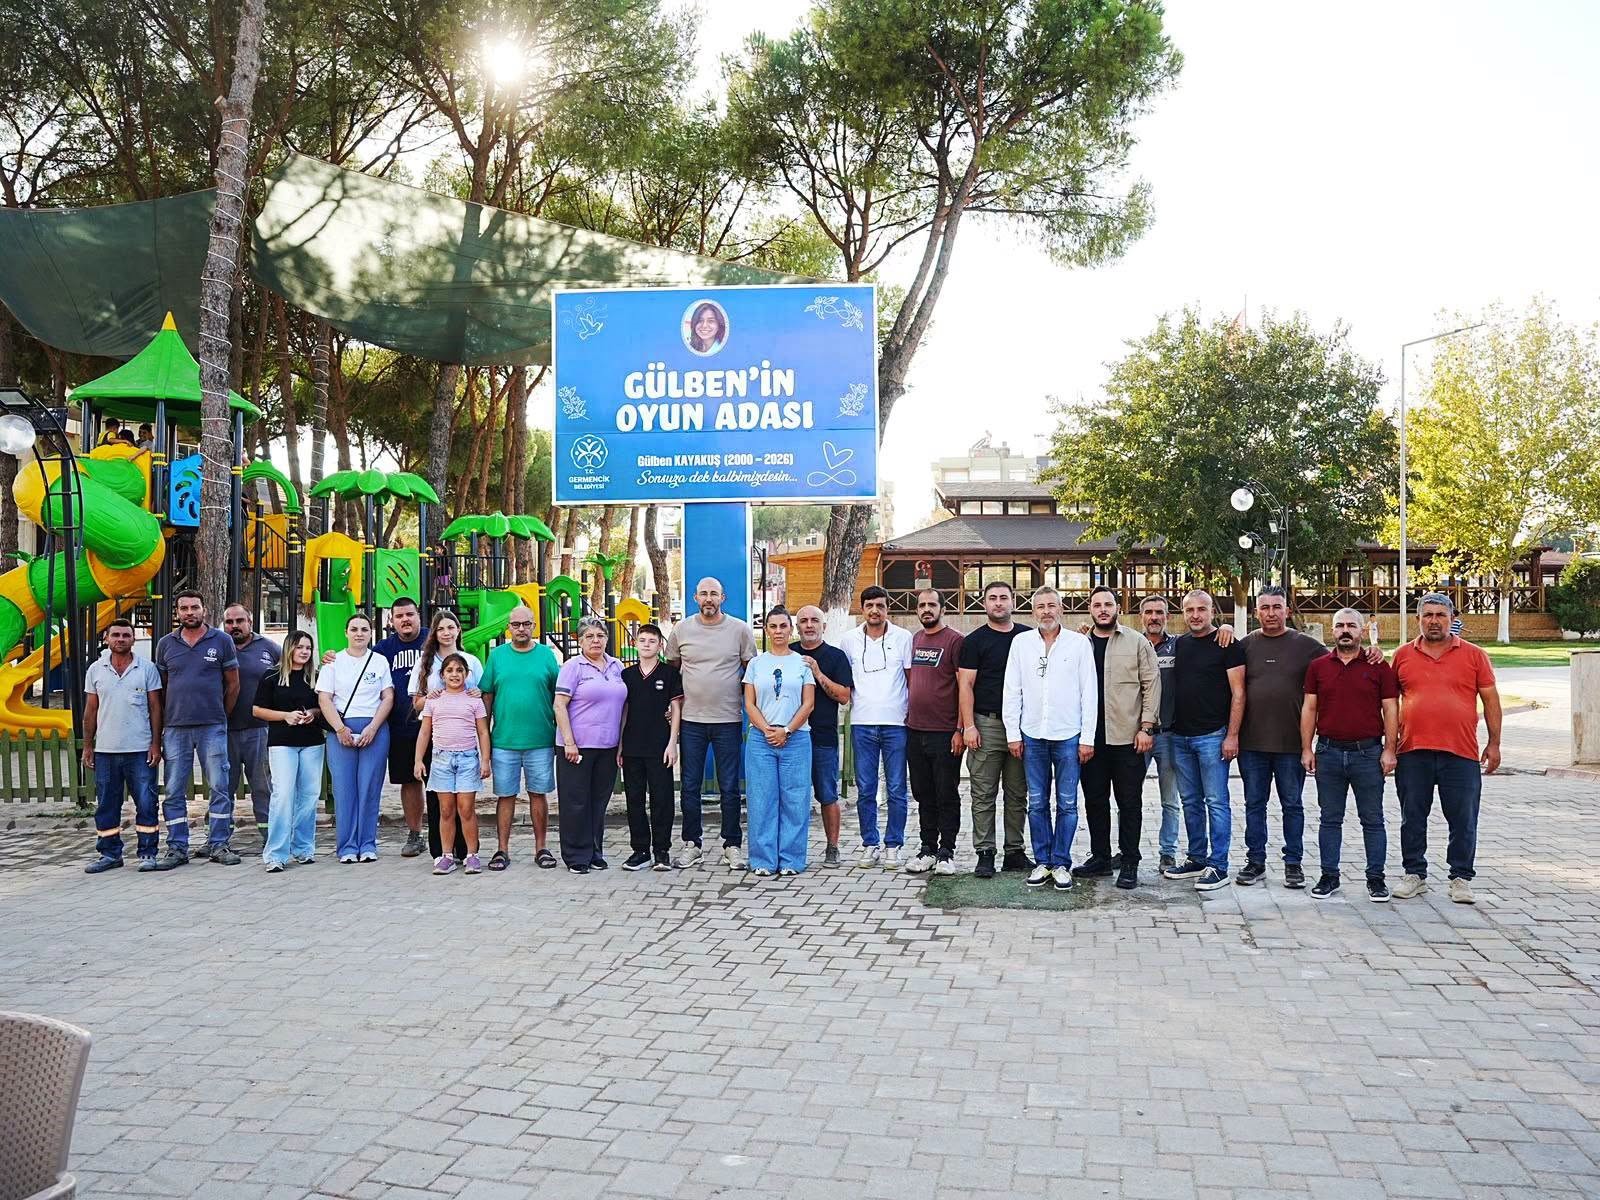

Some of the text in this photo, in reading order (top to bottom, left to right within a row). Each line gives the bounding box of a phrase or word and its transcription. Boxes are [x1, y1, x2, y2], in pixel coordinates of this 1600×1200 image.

[624, 360, 795, 399] GÜLBEN’İN
[616, 401, 814, 432] OYUN ADASI
[638, 455, 672, 467] Gülben
[674, 454, 720, 467] KAYAKUŞ
[724, 454, 753, 466] (2000
[764, 453, 794, 465] 2026)
[568, 475, 610, 483] GERMENCİK
[637, 470, 687, 488] Sonsuza
[689, 471, 711, 483] dek
